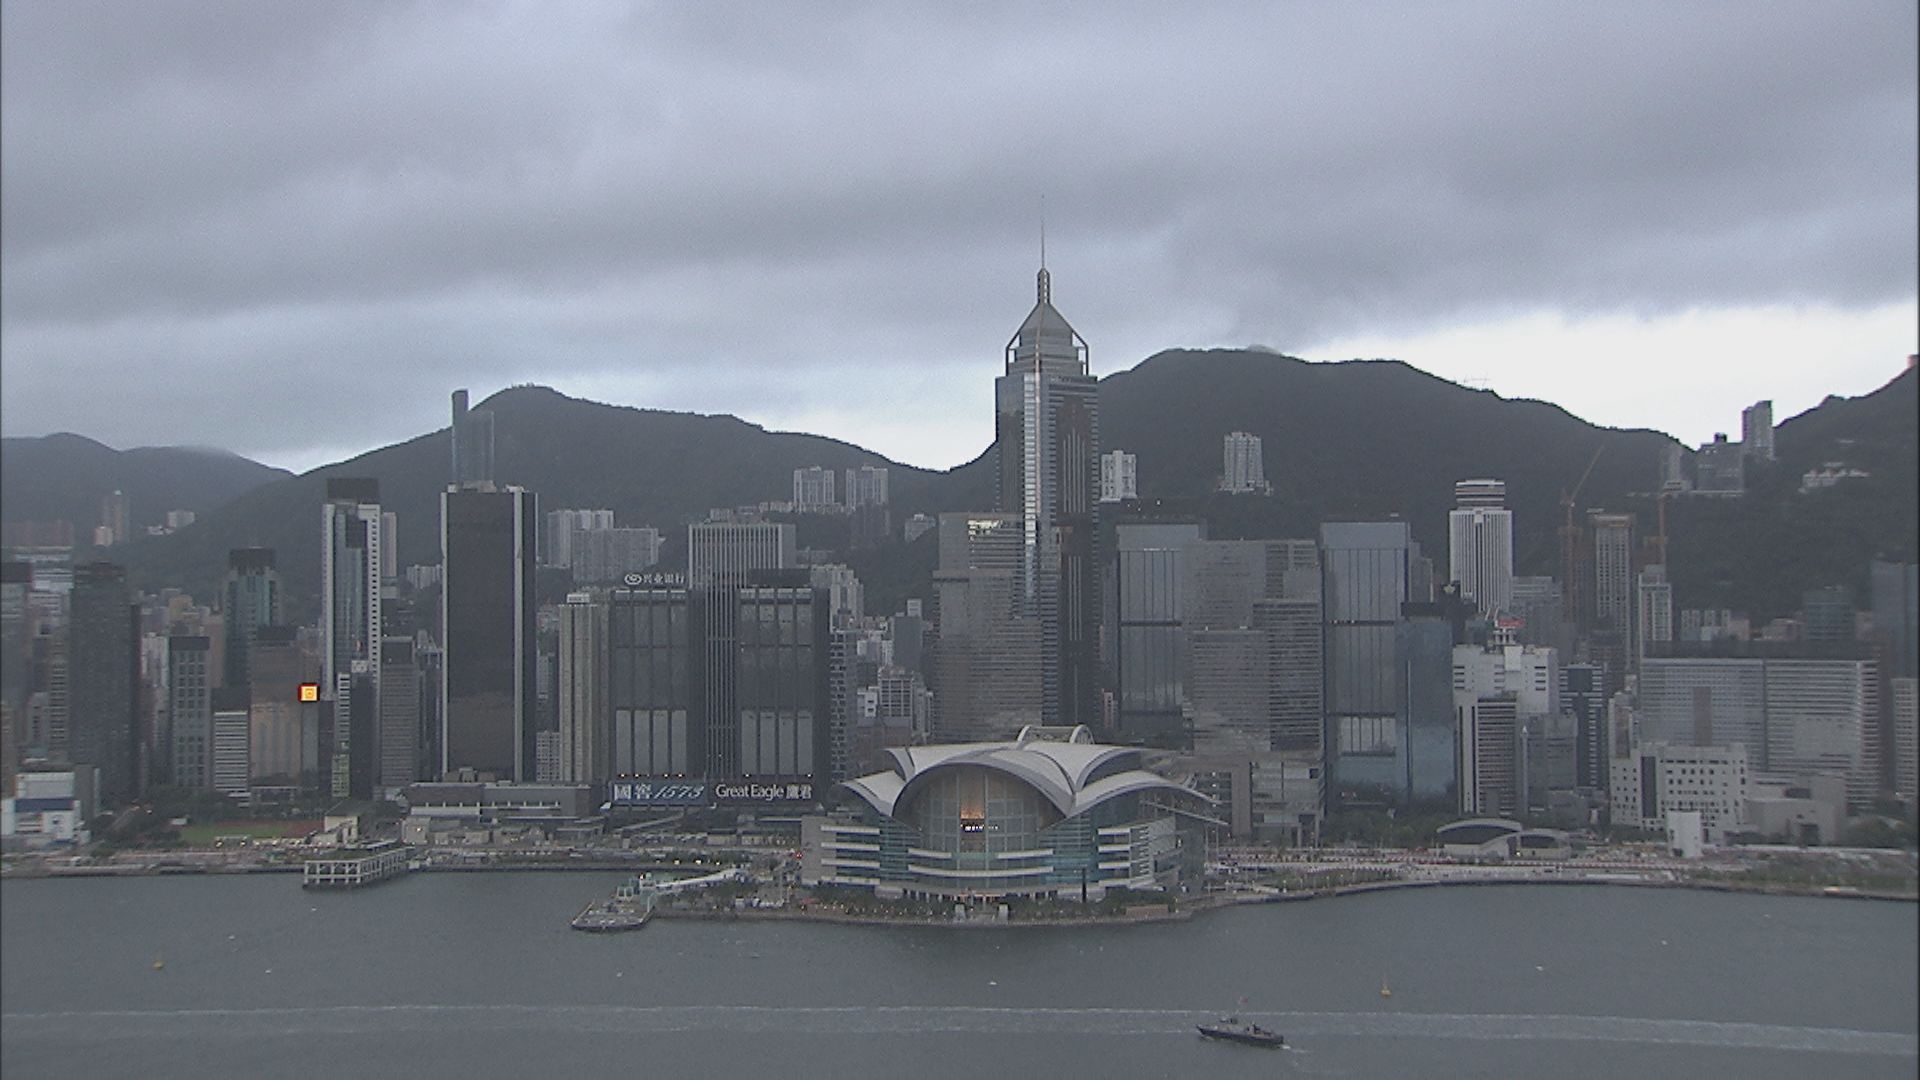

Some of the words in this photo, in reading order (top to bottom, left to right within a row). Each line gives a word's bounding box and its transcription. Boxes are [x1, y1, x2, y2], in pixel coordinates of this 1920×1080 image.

[653, 785, 705, 799] 1573
[715, 783, 749, 798] Great
[750, 783, 784, 801] Eagle
